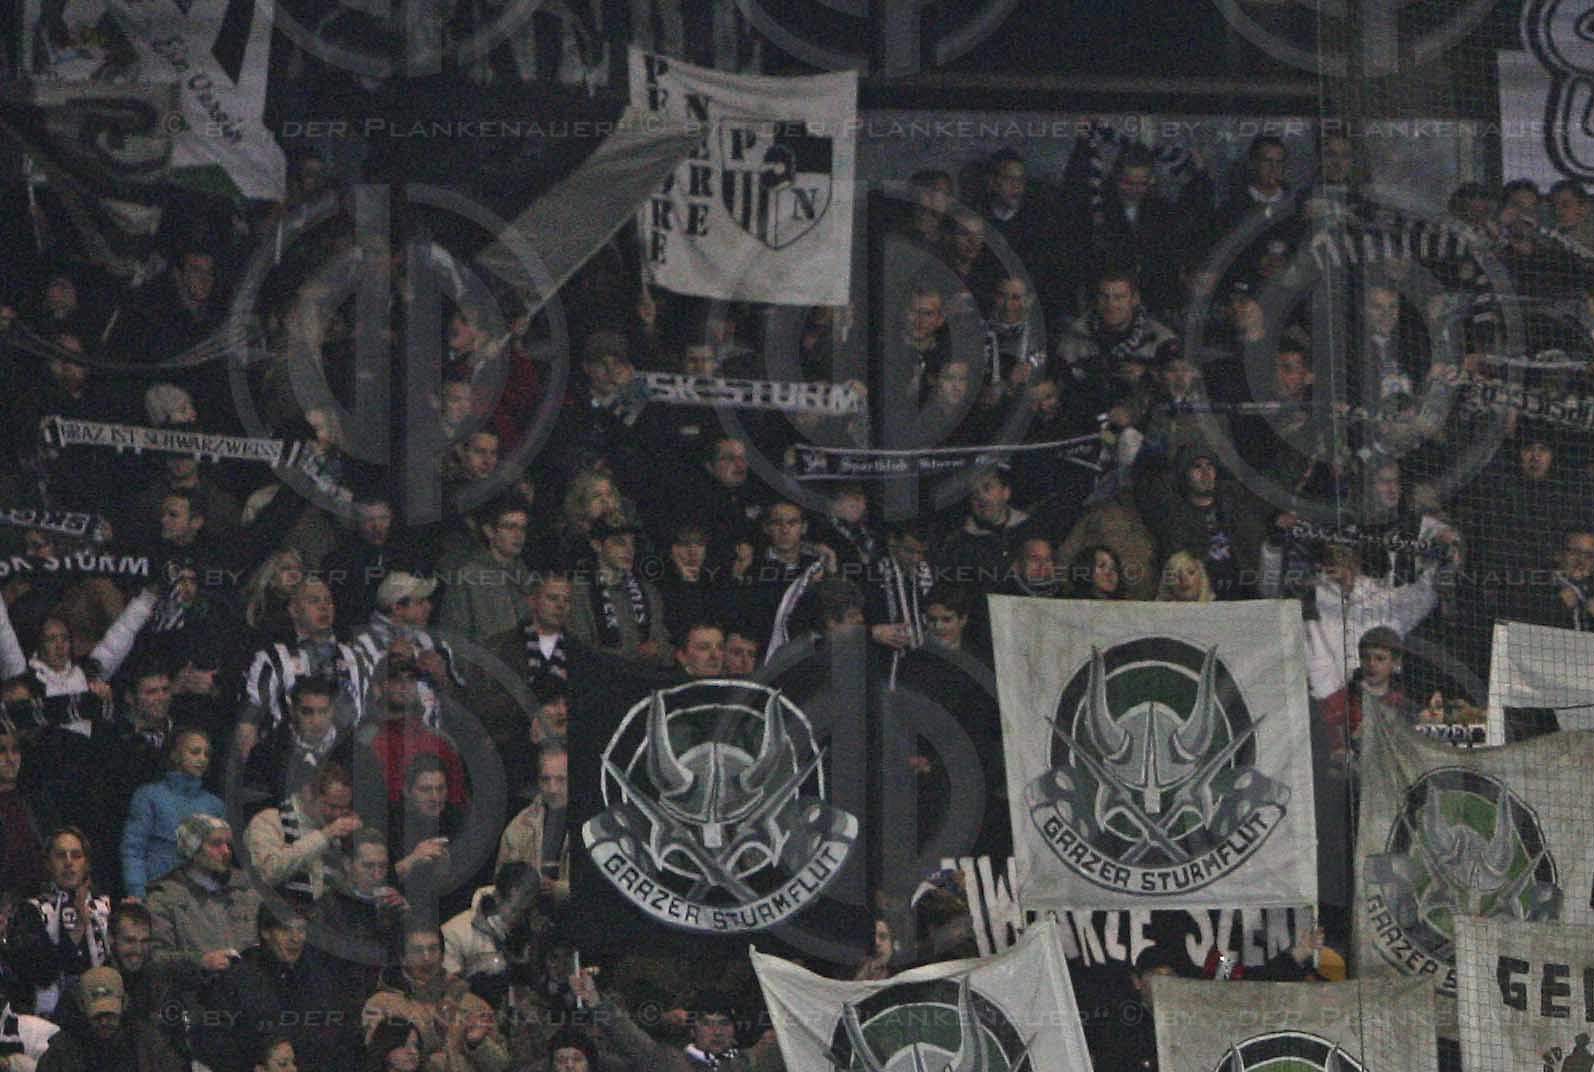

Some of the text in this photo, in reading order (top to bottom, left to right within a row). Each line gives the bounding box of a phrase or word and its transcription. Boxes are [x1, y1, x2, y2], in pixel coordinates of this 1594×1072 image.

[600, 846, 846, 931] GRAZER STURMFLUT
[1041, 811, 1272, 893] GRAZER STURMFLUT
[1365, 894, 1440, 978] GRAZER
